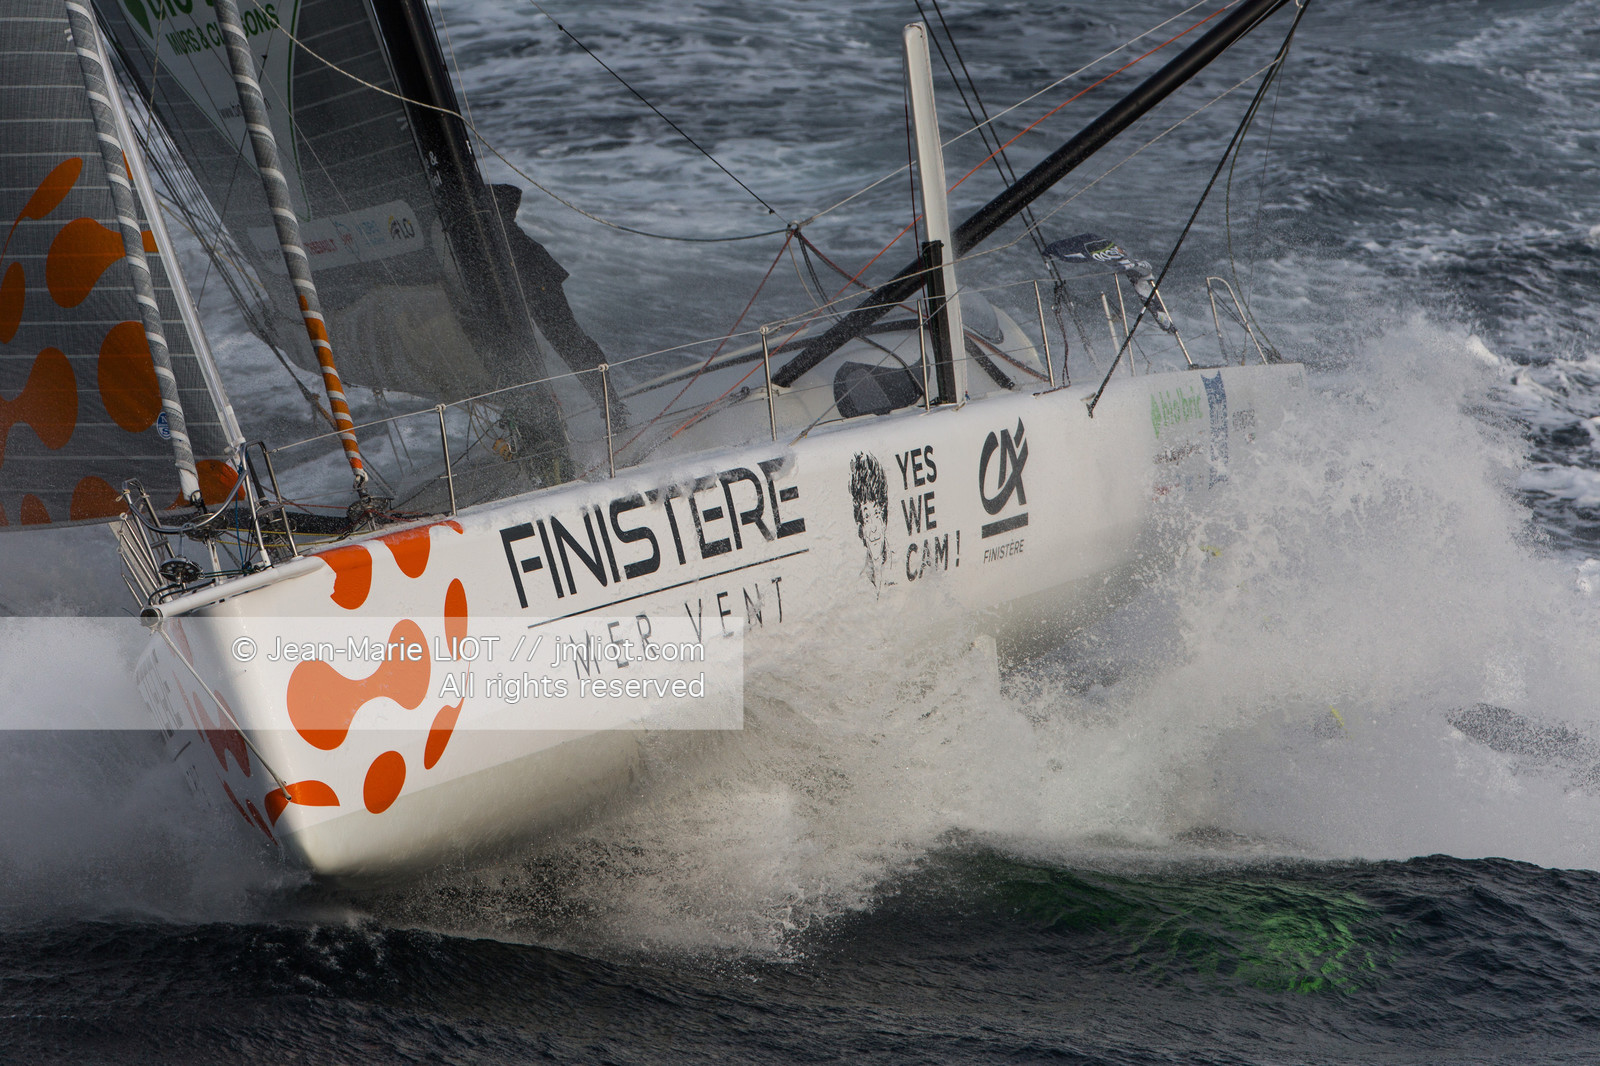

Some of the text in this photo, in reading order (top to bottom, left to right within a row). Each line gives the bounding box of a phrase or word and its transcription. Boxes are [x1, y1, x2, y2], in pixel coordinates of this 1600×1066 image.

[165, 28, 200, 56] MURS
[895, 445, 938, 491] YES
[901, 491, 937, 536] WE
[569, 576, 782, 680] MER VENT
